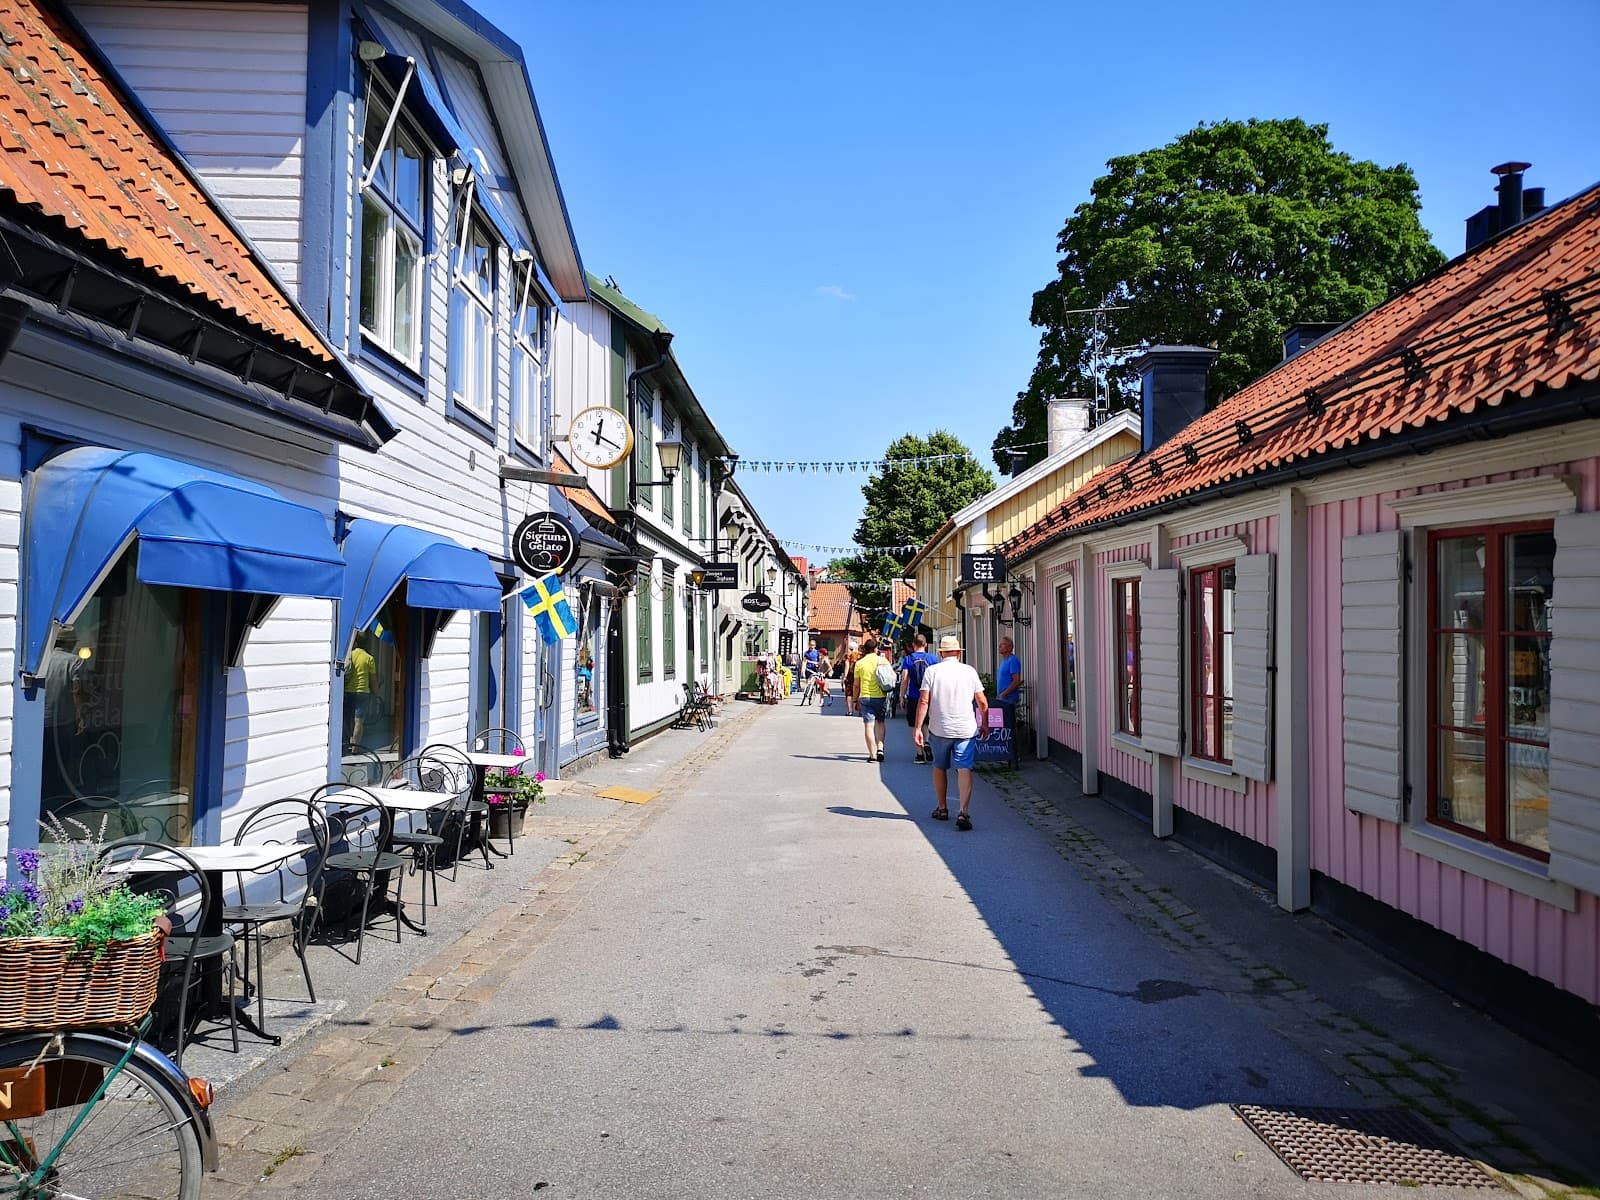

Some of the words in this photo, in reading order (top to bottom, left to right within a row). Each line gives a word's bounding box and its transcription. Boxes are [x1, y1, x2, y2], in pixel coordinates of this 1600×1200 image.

[525, 531, 567, 544] Sigtuna
[528, 541, 563, 551] Gelato
[973, 561, 994, 571] Cri
[973, 571, 994, 579] Cri
